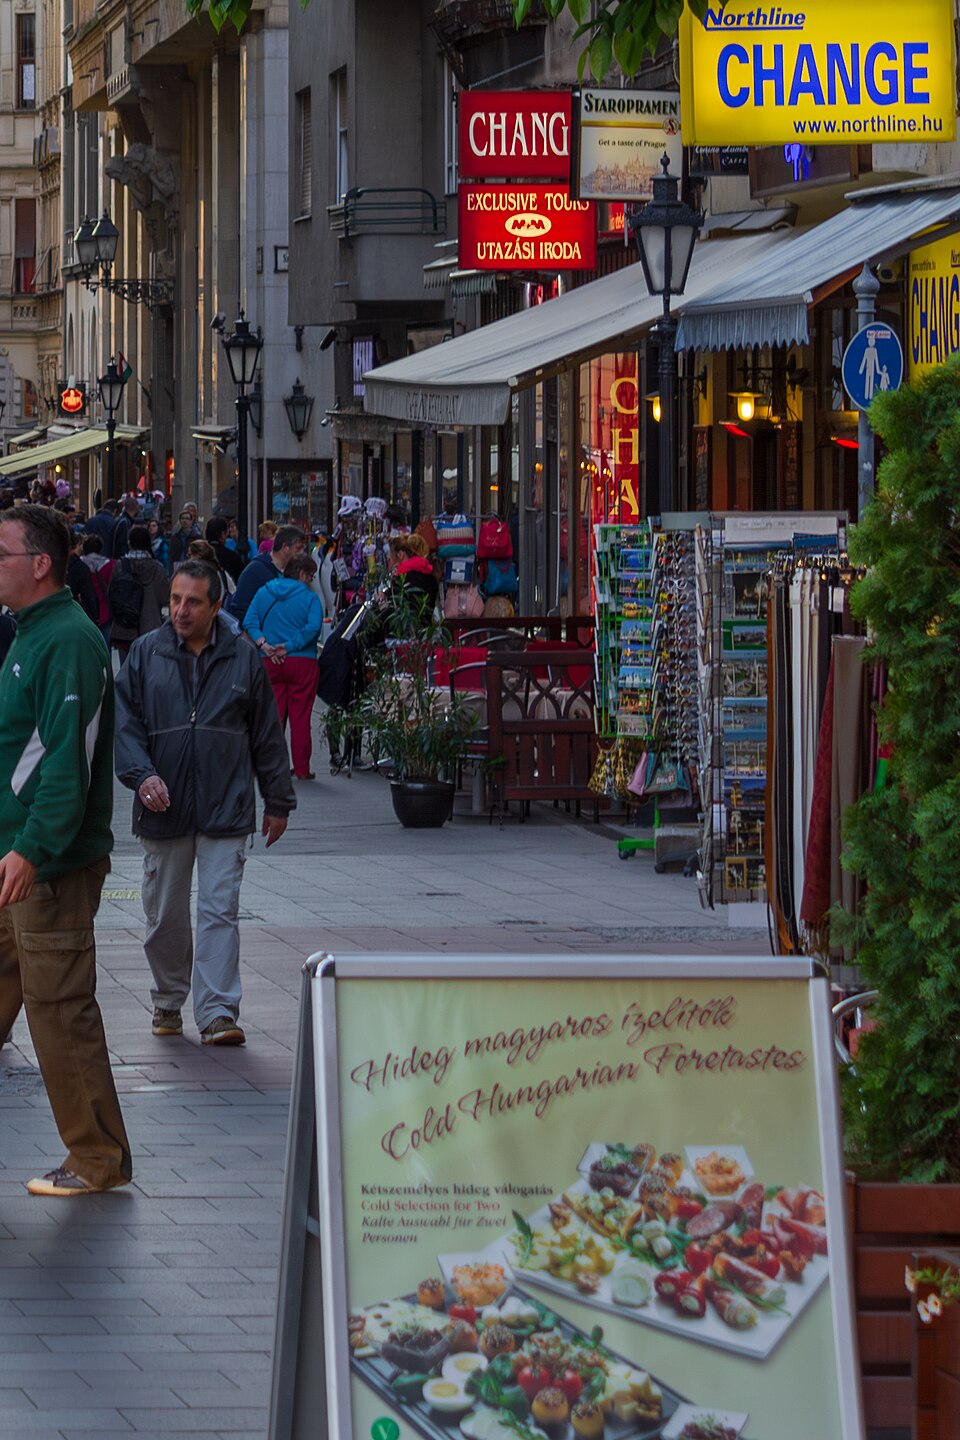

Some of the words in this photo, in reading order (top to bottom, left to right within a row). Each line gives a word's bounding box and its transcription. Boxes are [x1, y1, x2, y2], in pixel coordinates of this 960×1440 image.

[704, 7, 806, 27] Northline
[717, 41, 930, 108] CHANGE
[584, 93, 677, 116] STAROPRAMEN
[793, 114, 943, 134] www.northline.hu
[598, 139, 610, 147] Get
[617, 139, 634, 147] taste
[635, 139, 643, 147] of
[643, 140, 667, 149] Prague
[467, 193, 537, 211] EXCLUSIVE
[477, 237, 535, 260] UTAZÁSI
[540, 241, 582, 260] IRODA
[350, 1046, 457, 1092] Hideg
[464, 1014, 614, 1065] magyaros
[381, 1103, 457, 1161] Cold
[458, 1061, 640, 1120] Hungarian
[643, 1043, 807, 1074] Foretastes
[361, 1183, 449, 1197] Kétszemélyes
[453, 1183, 490, 1197] hideg
[494, 1183, 554, 1197] válogatás
[361, 1200, 391, 1211] Cold
[394, 1200, 450, 1211] Selection
[454, 1200, 472, 1211] for
[474, 1200, 501, 1211] Two
[362, 1216, 394, 1228] Kalte
[397, 1216, 450, 1228] Auswahl
[453, 1216, 473, 1230] für
[476, 1216, 507, 1228] Zwei
[362, 1232, 418, 1244] Personen
